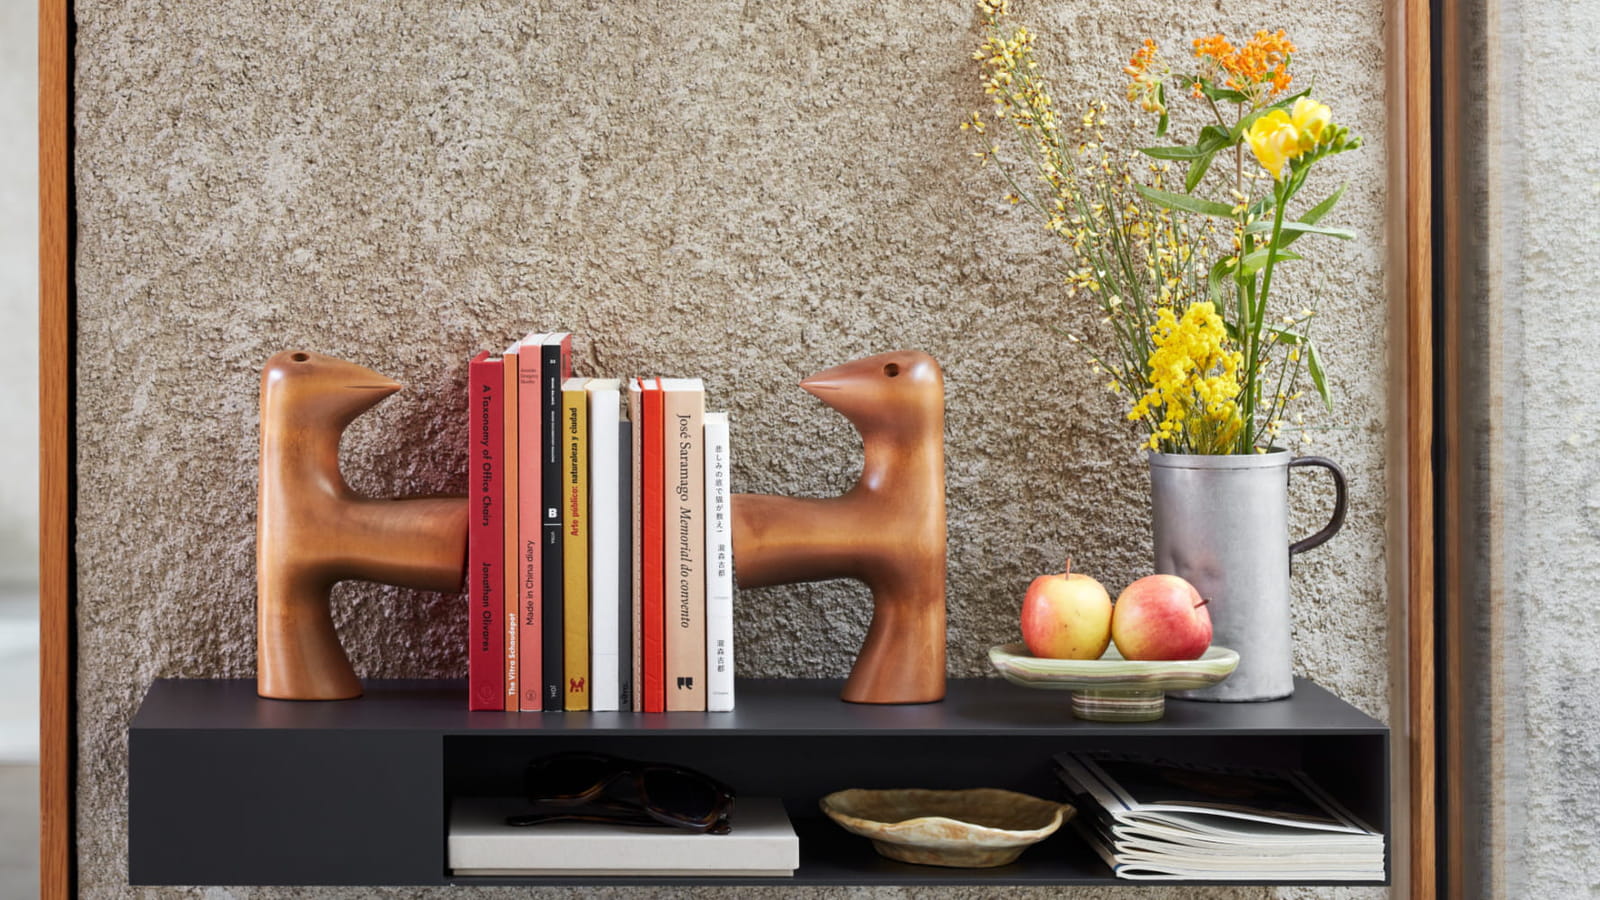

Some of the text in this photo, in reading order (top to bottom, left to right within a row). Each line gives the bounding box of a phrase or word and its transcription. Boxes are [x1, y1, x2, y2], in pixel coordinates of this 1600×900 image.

[569, 407, 578, 434] ciudad
[480, 385, 493, 527] A Taxonomy of Office Chairs
[569, 443, 578, 484] naturaleza
[548, 507, 558, 519] B
[570, 486, 580, 518] público:
[570, 519, 579, 537] Arte
[676, 414, 693, 629] José Saramago Memorial do convento
[481, 562, 493, 652] Jonathan Olivares
[526, 540, 535, 626] Made in China diary
[508, 612, 518, 696] The Vitra Schaudepot
